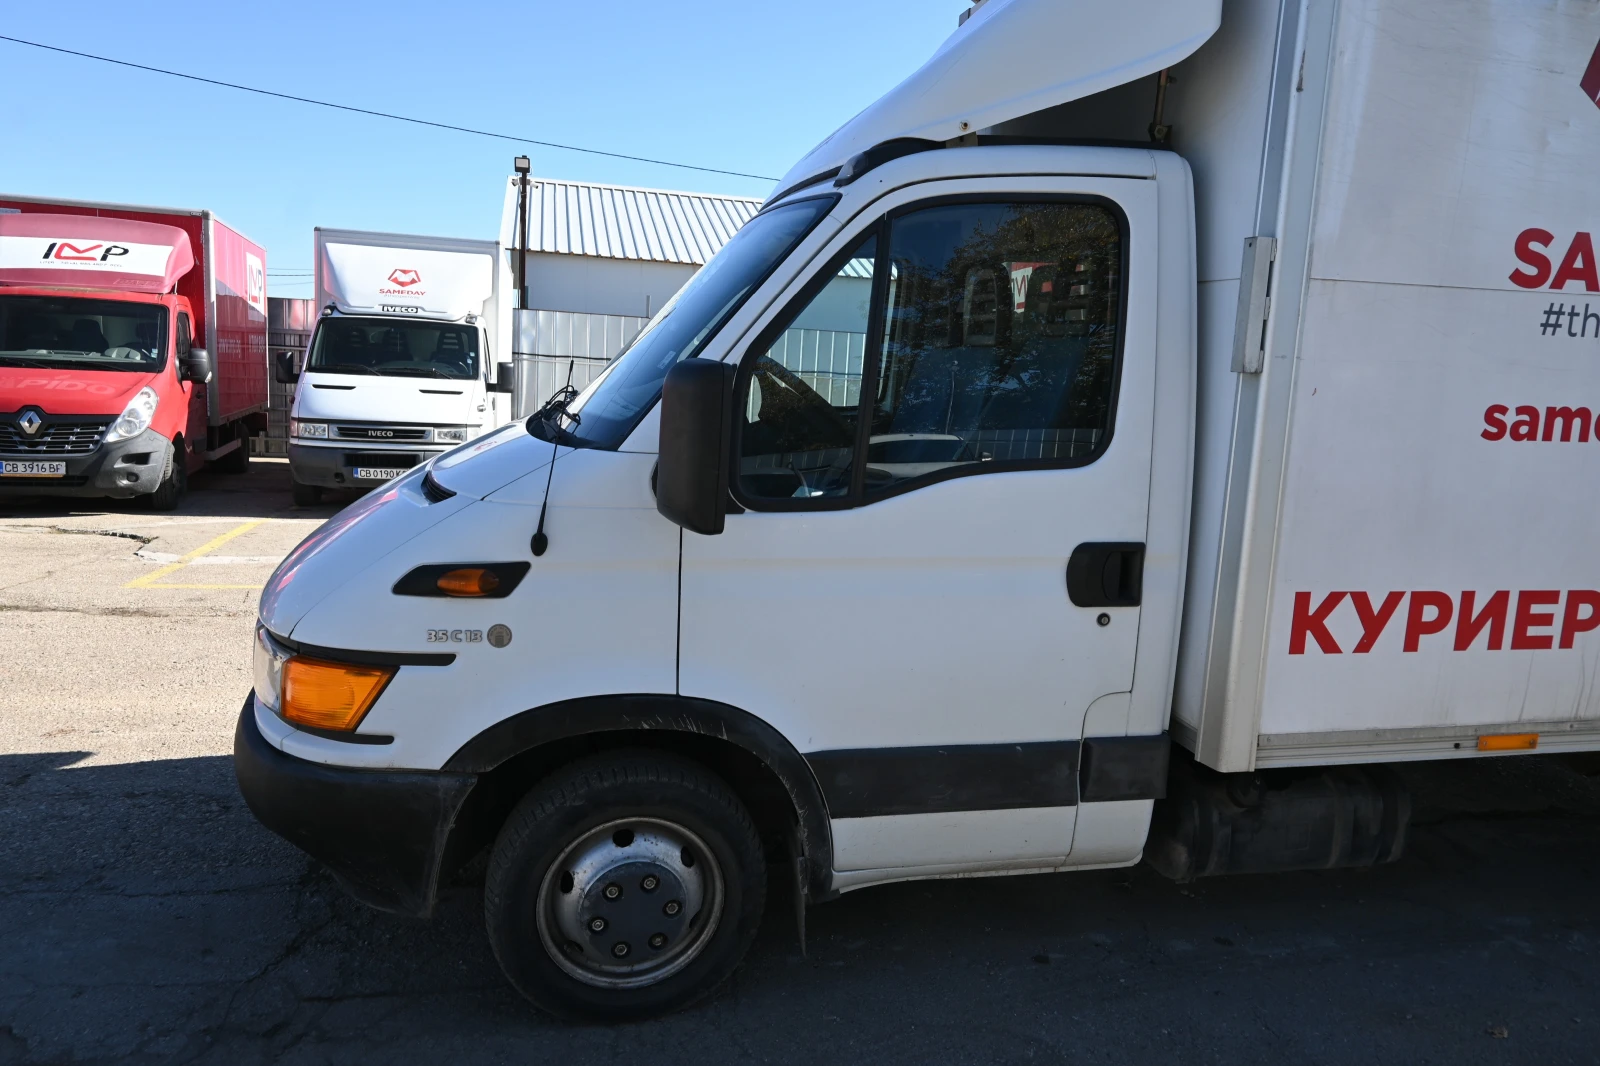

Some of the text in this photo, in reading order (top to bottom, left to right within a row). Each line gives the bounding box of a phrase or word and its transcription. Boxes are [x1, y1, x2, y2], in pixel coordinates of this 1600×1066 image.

[1509, 227, 1600, 293] SA
[379, 288, 426, 296] SAMEDAY
[1540, 302, 1600, 338] #th
[1480, 403, 1600, 443] sam
[21, 463, 47, 473] 3916
[373, 469, 394, 479] 0190
[1288, 589, 1600, 655] КУРИЕР
